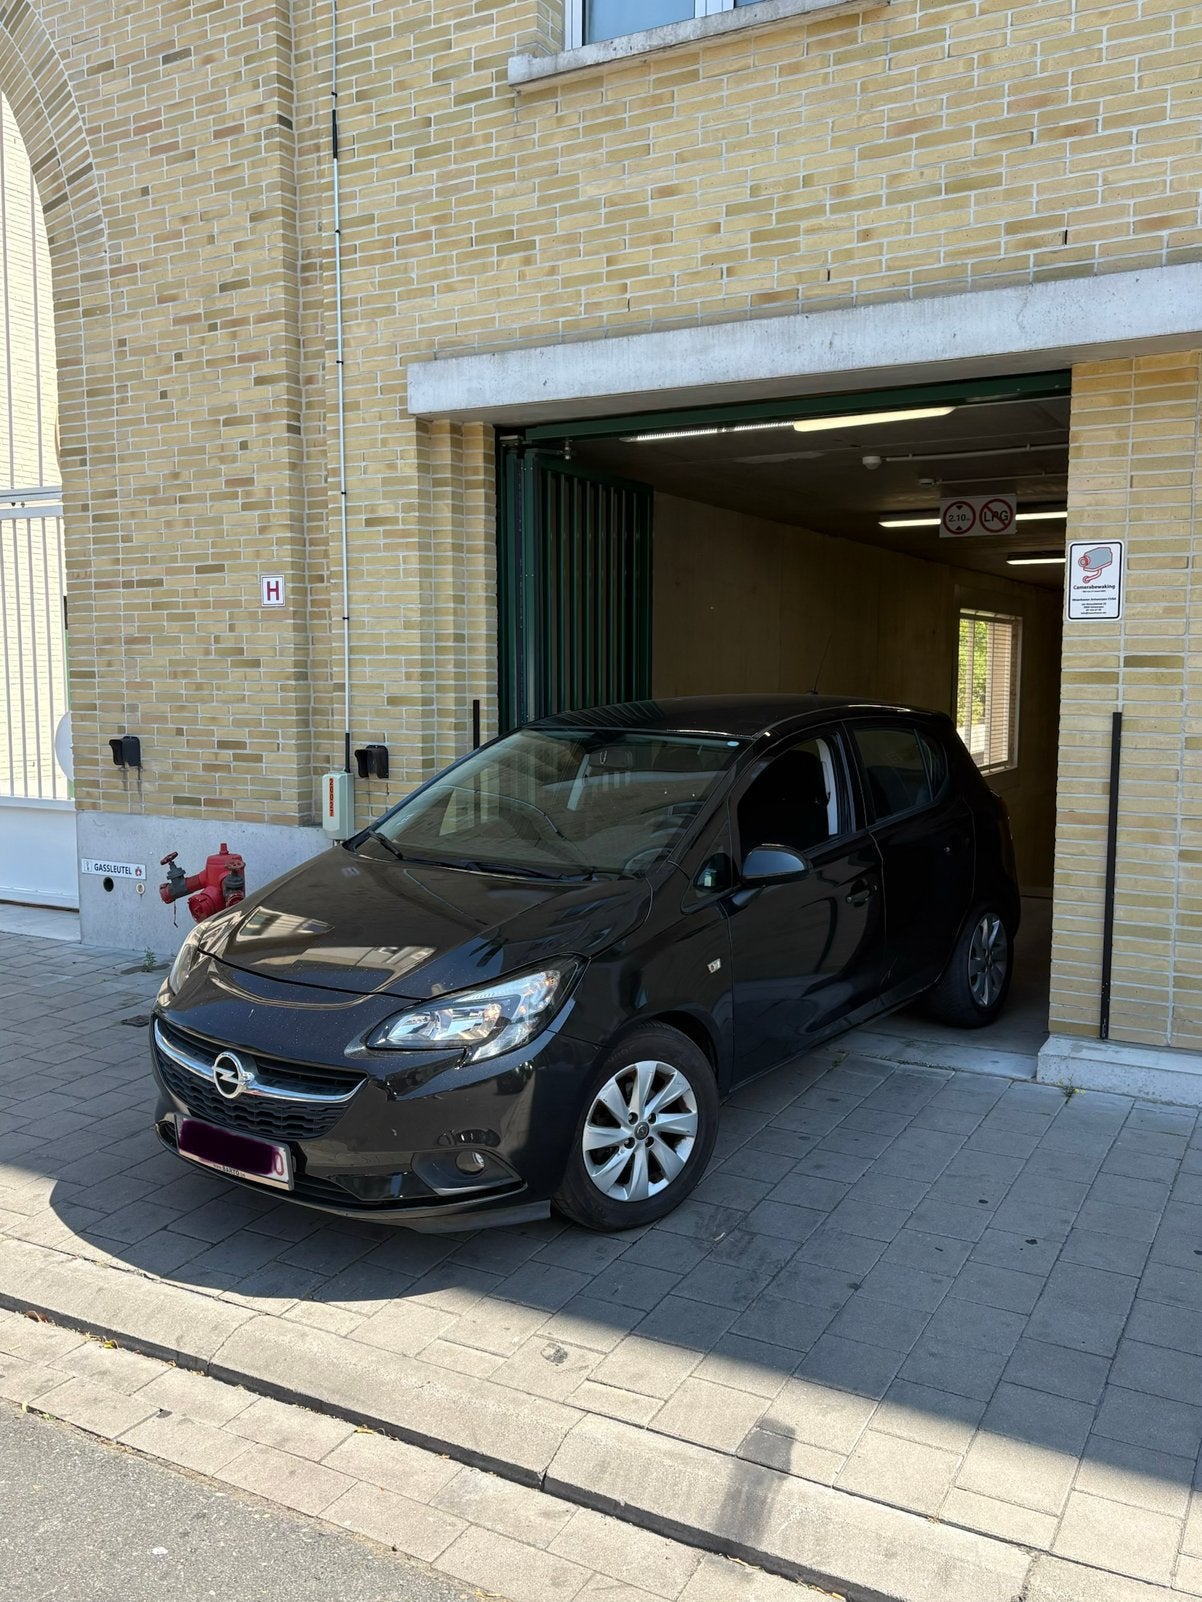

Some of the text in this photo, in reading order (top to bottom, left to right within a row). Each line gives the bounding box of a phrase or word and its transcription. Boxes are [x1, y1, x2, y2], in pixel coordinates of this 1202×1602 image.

[983, 510, 1008, 522] LPG
[267, 581, 279, 601] H
[94, 863, 132, 875] GASSLEUTEL
